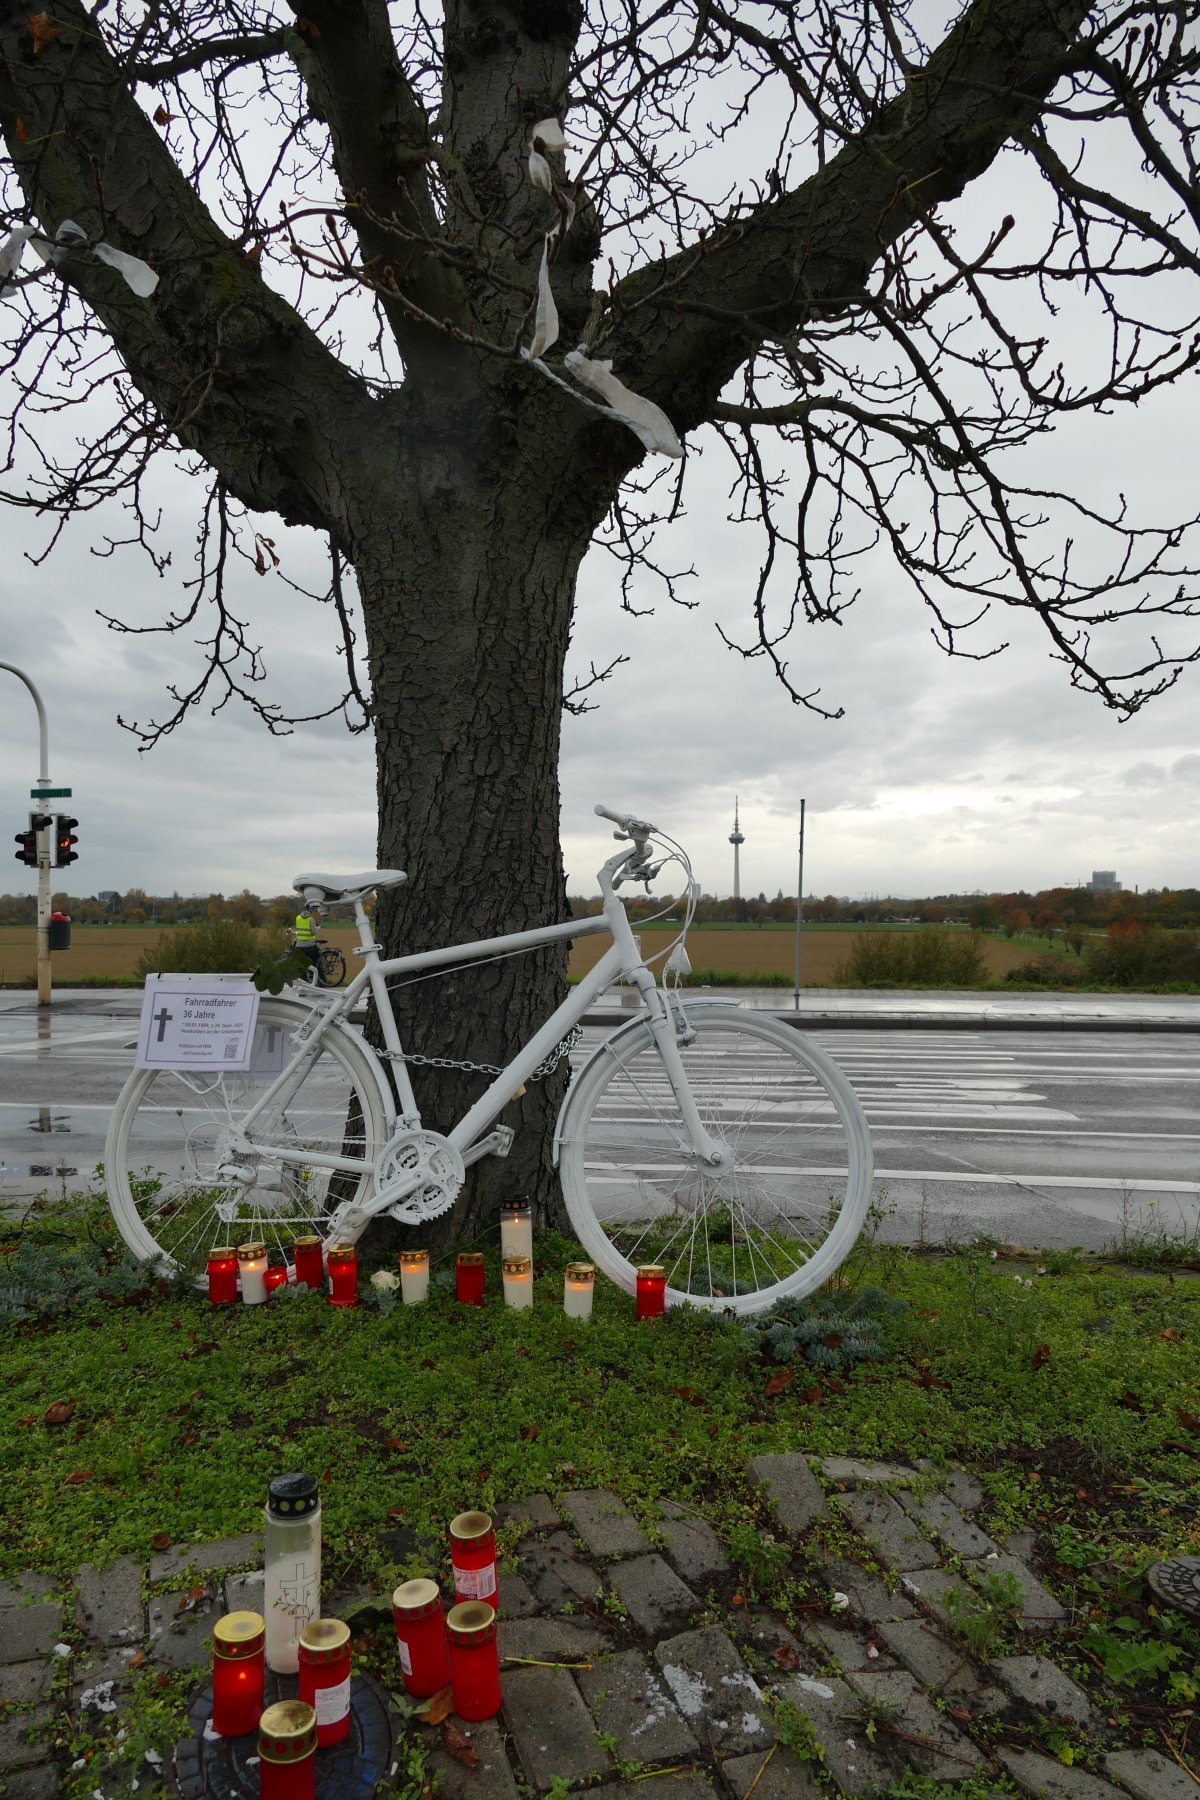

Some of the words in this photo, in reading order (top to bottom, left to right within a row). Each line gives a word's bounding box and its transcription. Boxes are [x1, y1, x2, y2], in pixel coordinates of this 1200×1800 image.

[184, 997, 237, 1007] Fahrradfahrer
[183, 1010, 193, 1019] 36
[193, 1010, 216, 1019] Jahre
